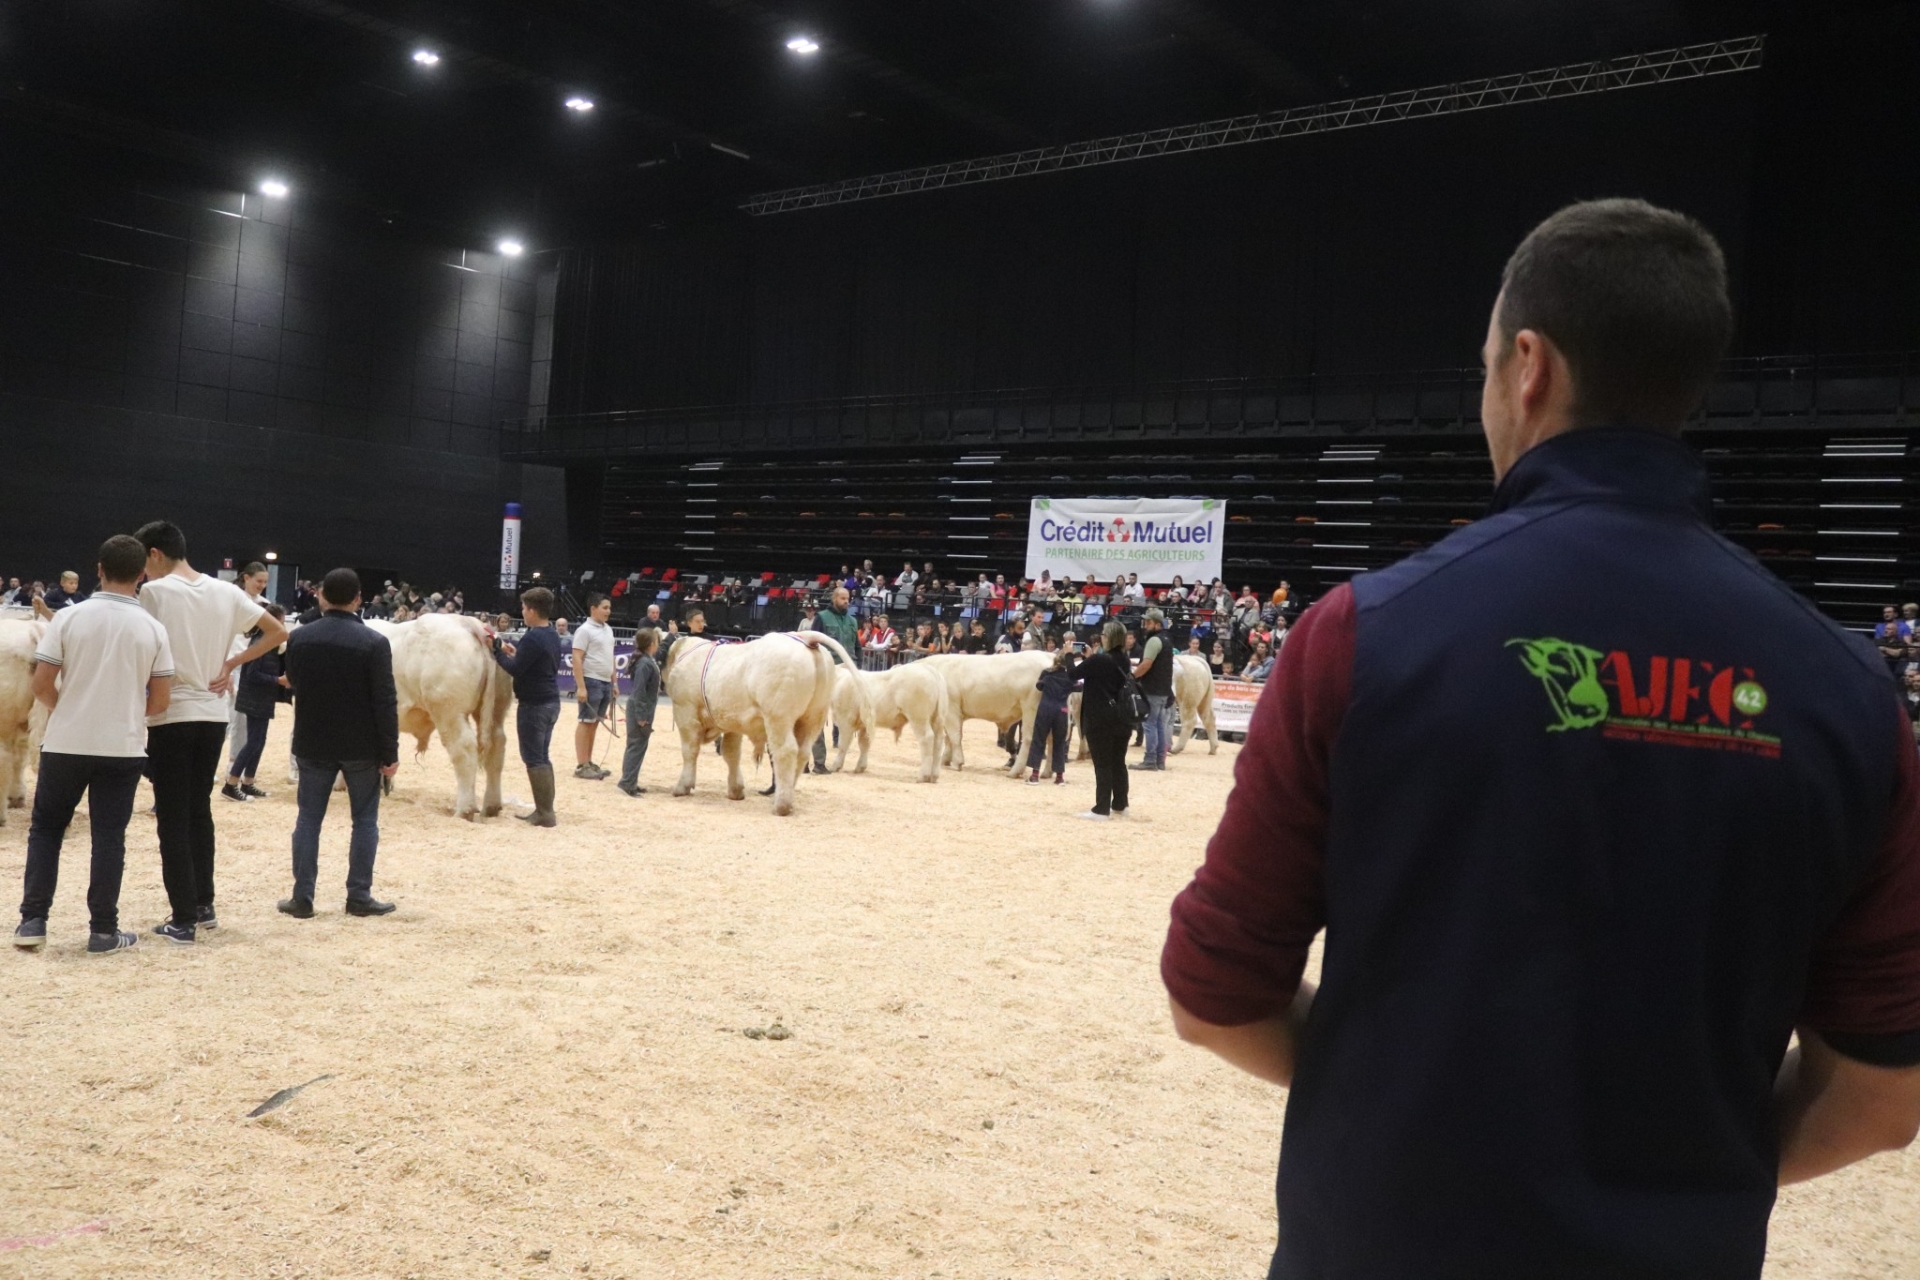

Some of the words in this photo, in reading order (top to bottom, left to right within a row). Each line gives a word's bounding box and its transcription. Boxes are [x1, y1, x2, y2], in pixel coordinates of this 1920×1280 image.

[505, 527, 513, 555] Mutuel
[1040, 518, 1105, 542] Crédit
[1133, 520, 1213, 544] Mutuel
[1045, 547, 1104, 560] PARTENAIRE
[1106, 548, 1125, 560] DES
[1127, 548, 1206, 562] AGRICULTEURS
[1735, 688, 1762, 710] 42
